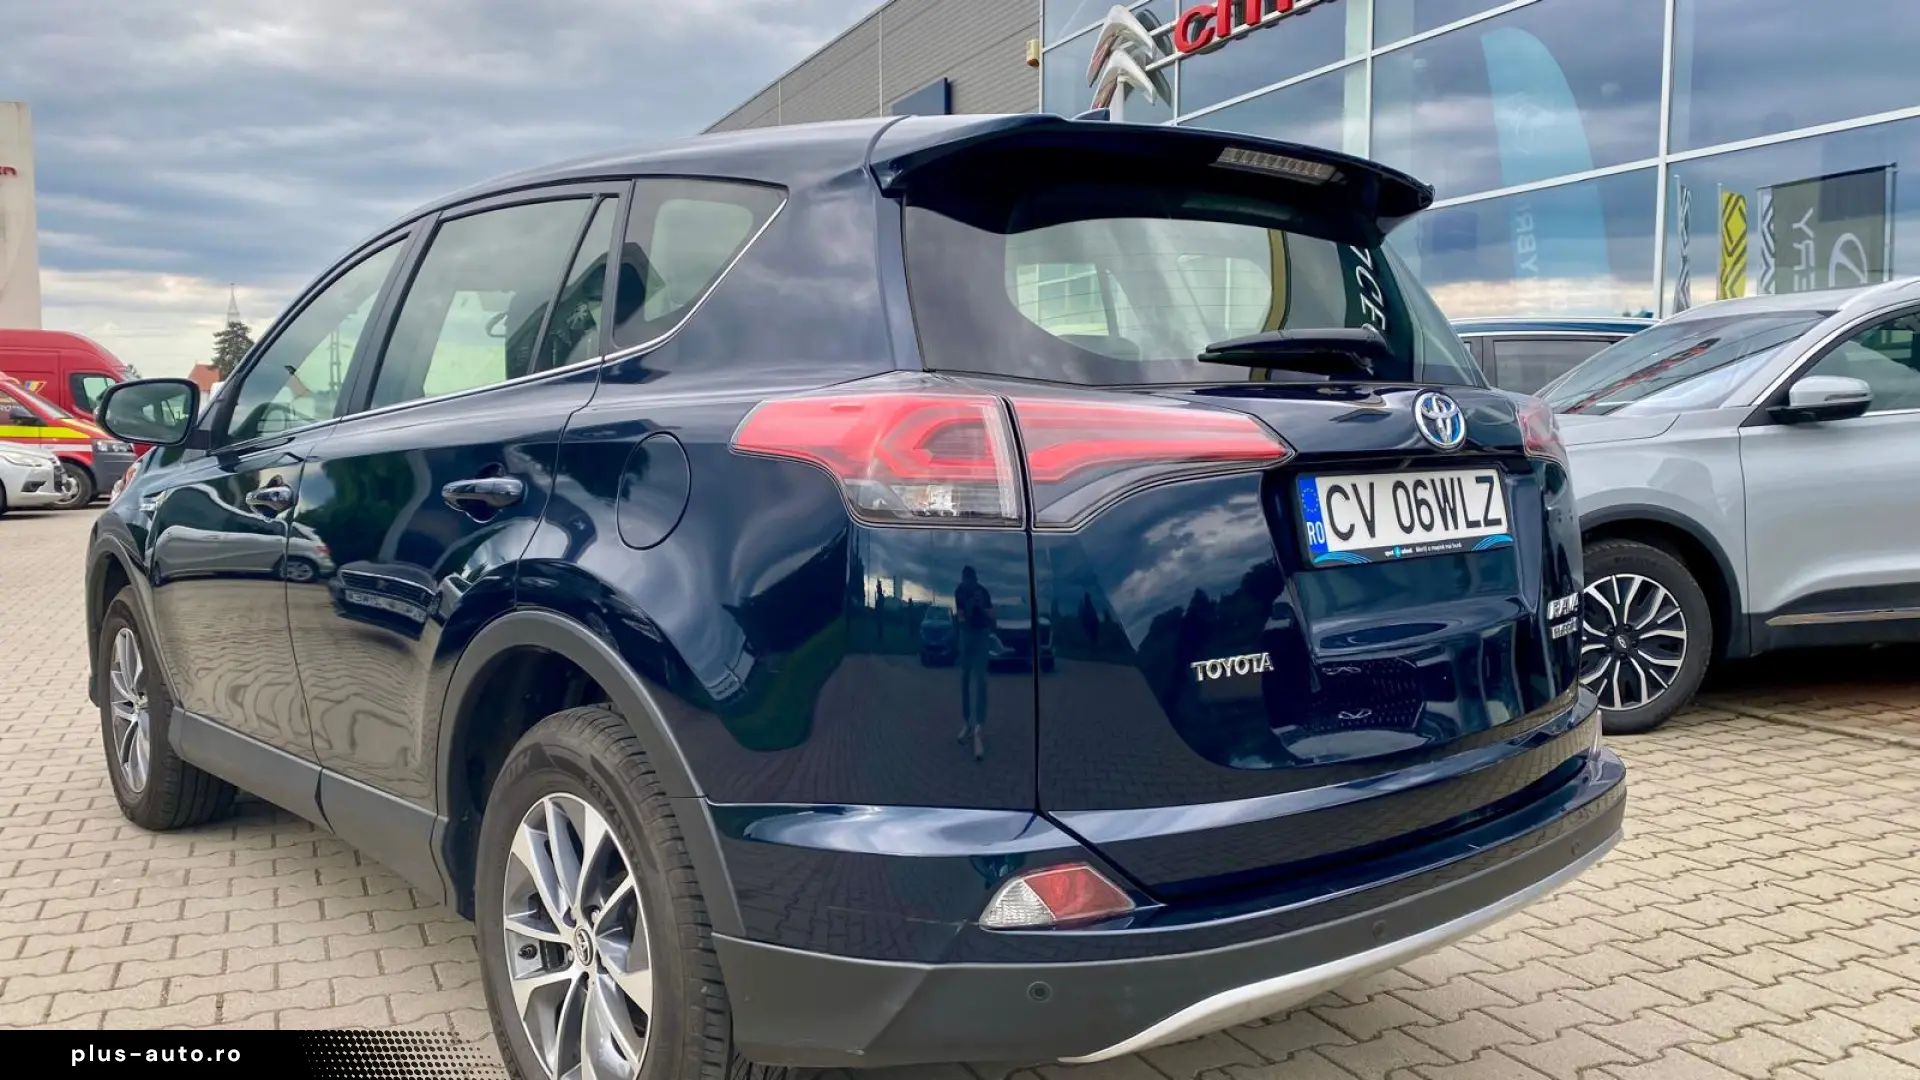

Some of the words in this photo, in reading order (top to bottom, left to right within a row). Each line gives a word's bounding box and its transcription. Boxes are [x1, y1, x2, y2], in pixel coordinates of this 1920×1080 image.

[1325, 481, 1376, 542] CV
[1391, 475, 1502, 535] 06WLZ
[1306, 521, 1326, 546] RO
[1190, 652, 1275, 681] TOYOTA
